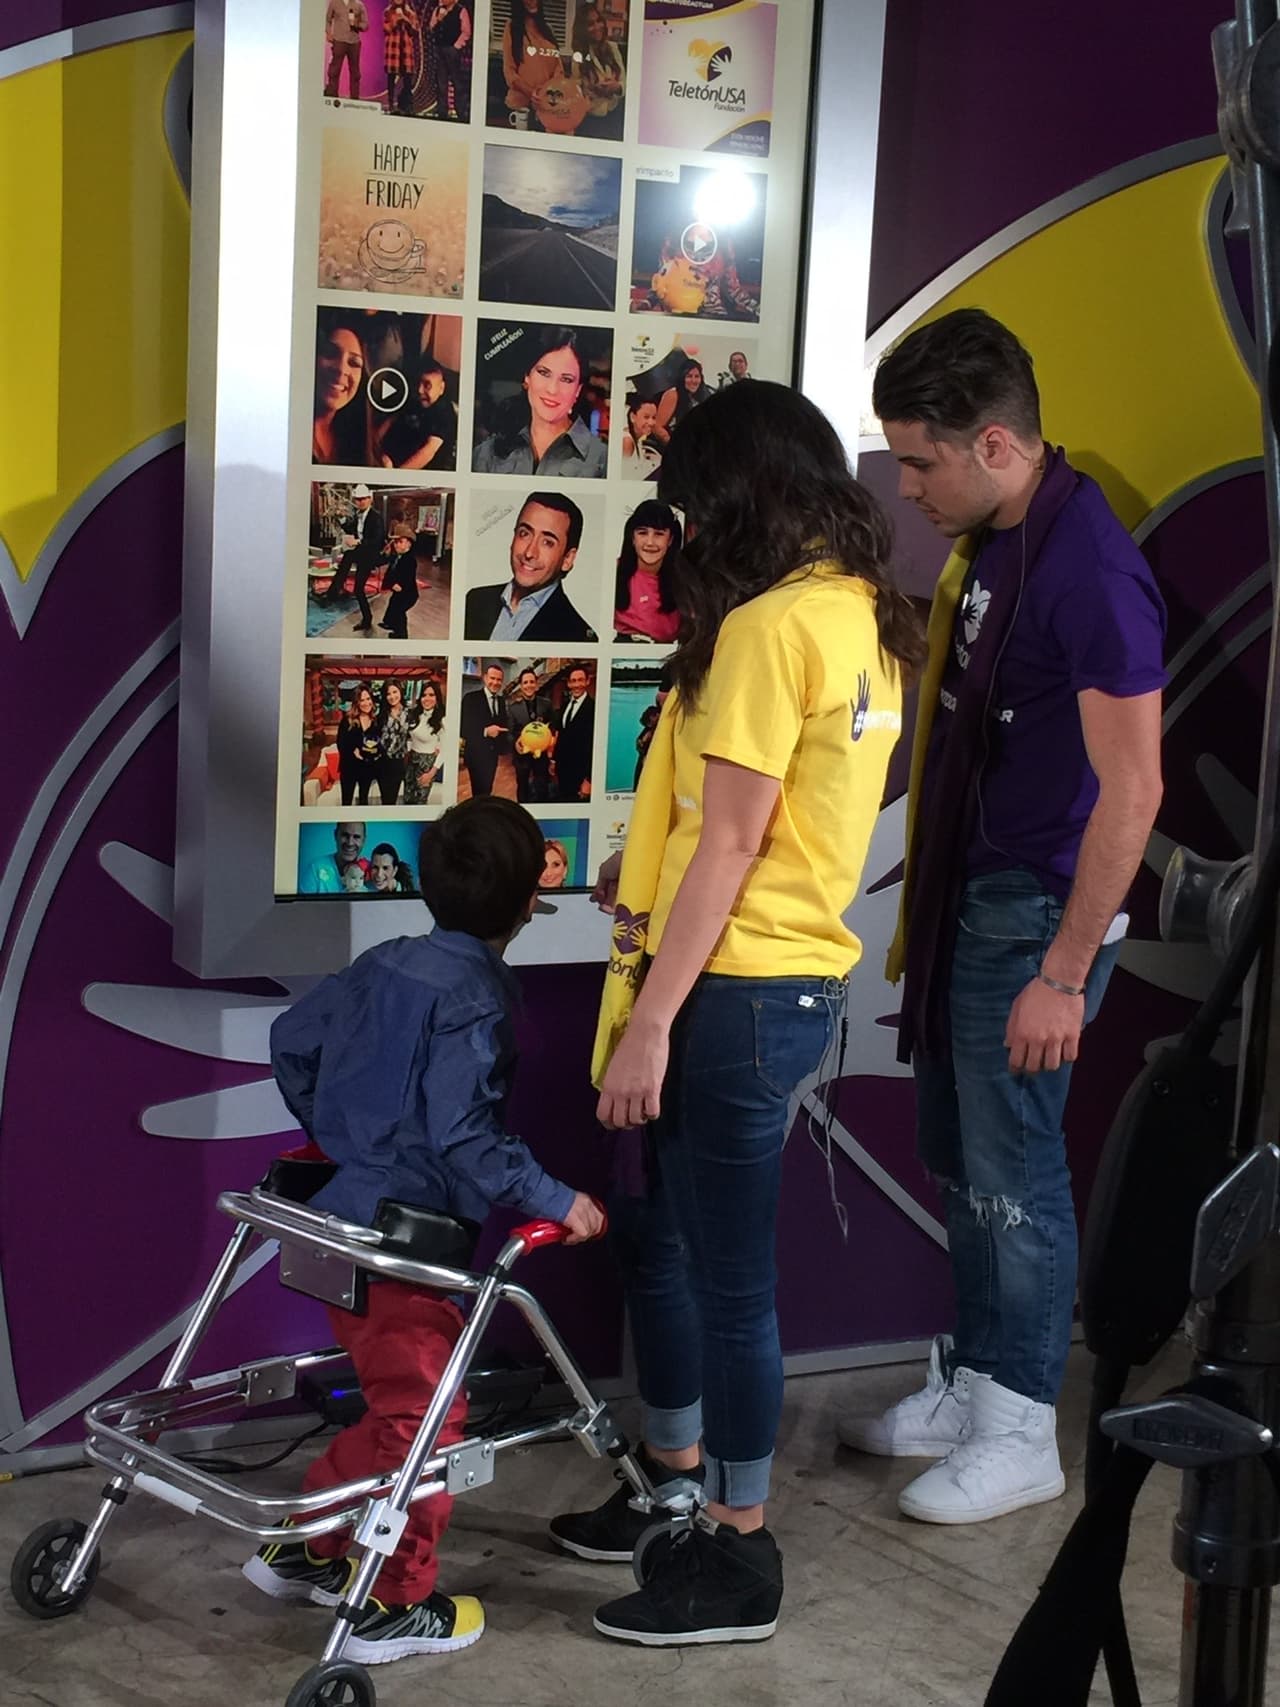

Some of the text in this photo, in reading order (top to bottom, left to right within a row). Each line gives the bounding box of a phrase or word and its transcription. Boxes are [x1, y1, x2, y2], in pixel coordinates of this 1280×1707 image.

[668, 80, 746, 104] TeletónUSA
[373, 143, 419, 174] HAPPY
[365, 179, 424, 210] FRIDAY
